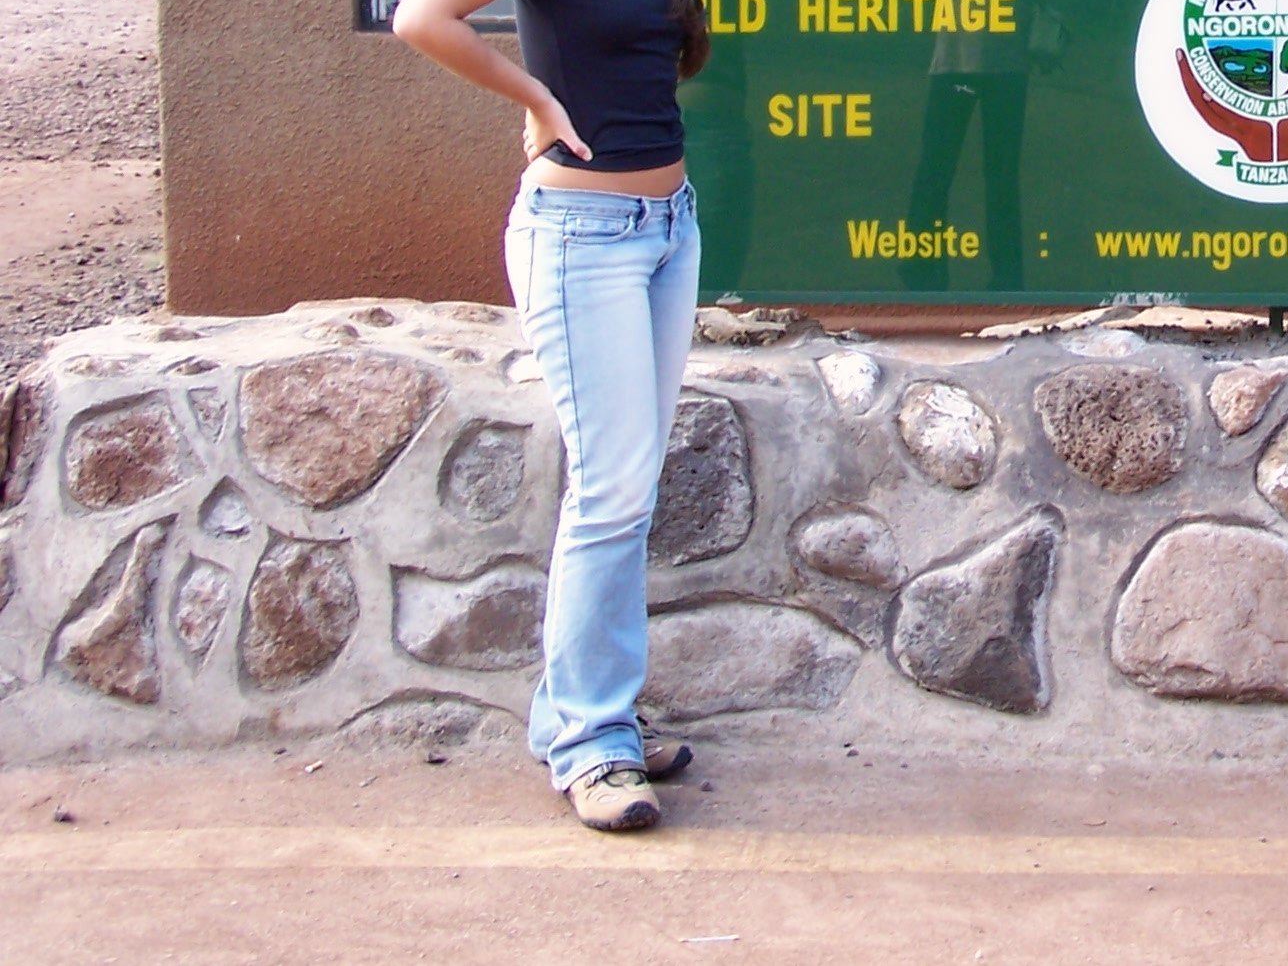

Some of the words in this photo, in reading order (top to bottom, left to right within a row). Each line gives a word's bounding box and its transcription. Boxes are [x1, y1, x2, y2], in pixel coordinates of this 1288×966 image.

[1190, 46, 1265, 116] CONSERVATION
[768, 93, 872, 137] SITE
[847, 220, 980, 259] Website
